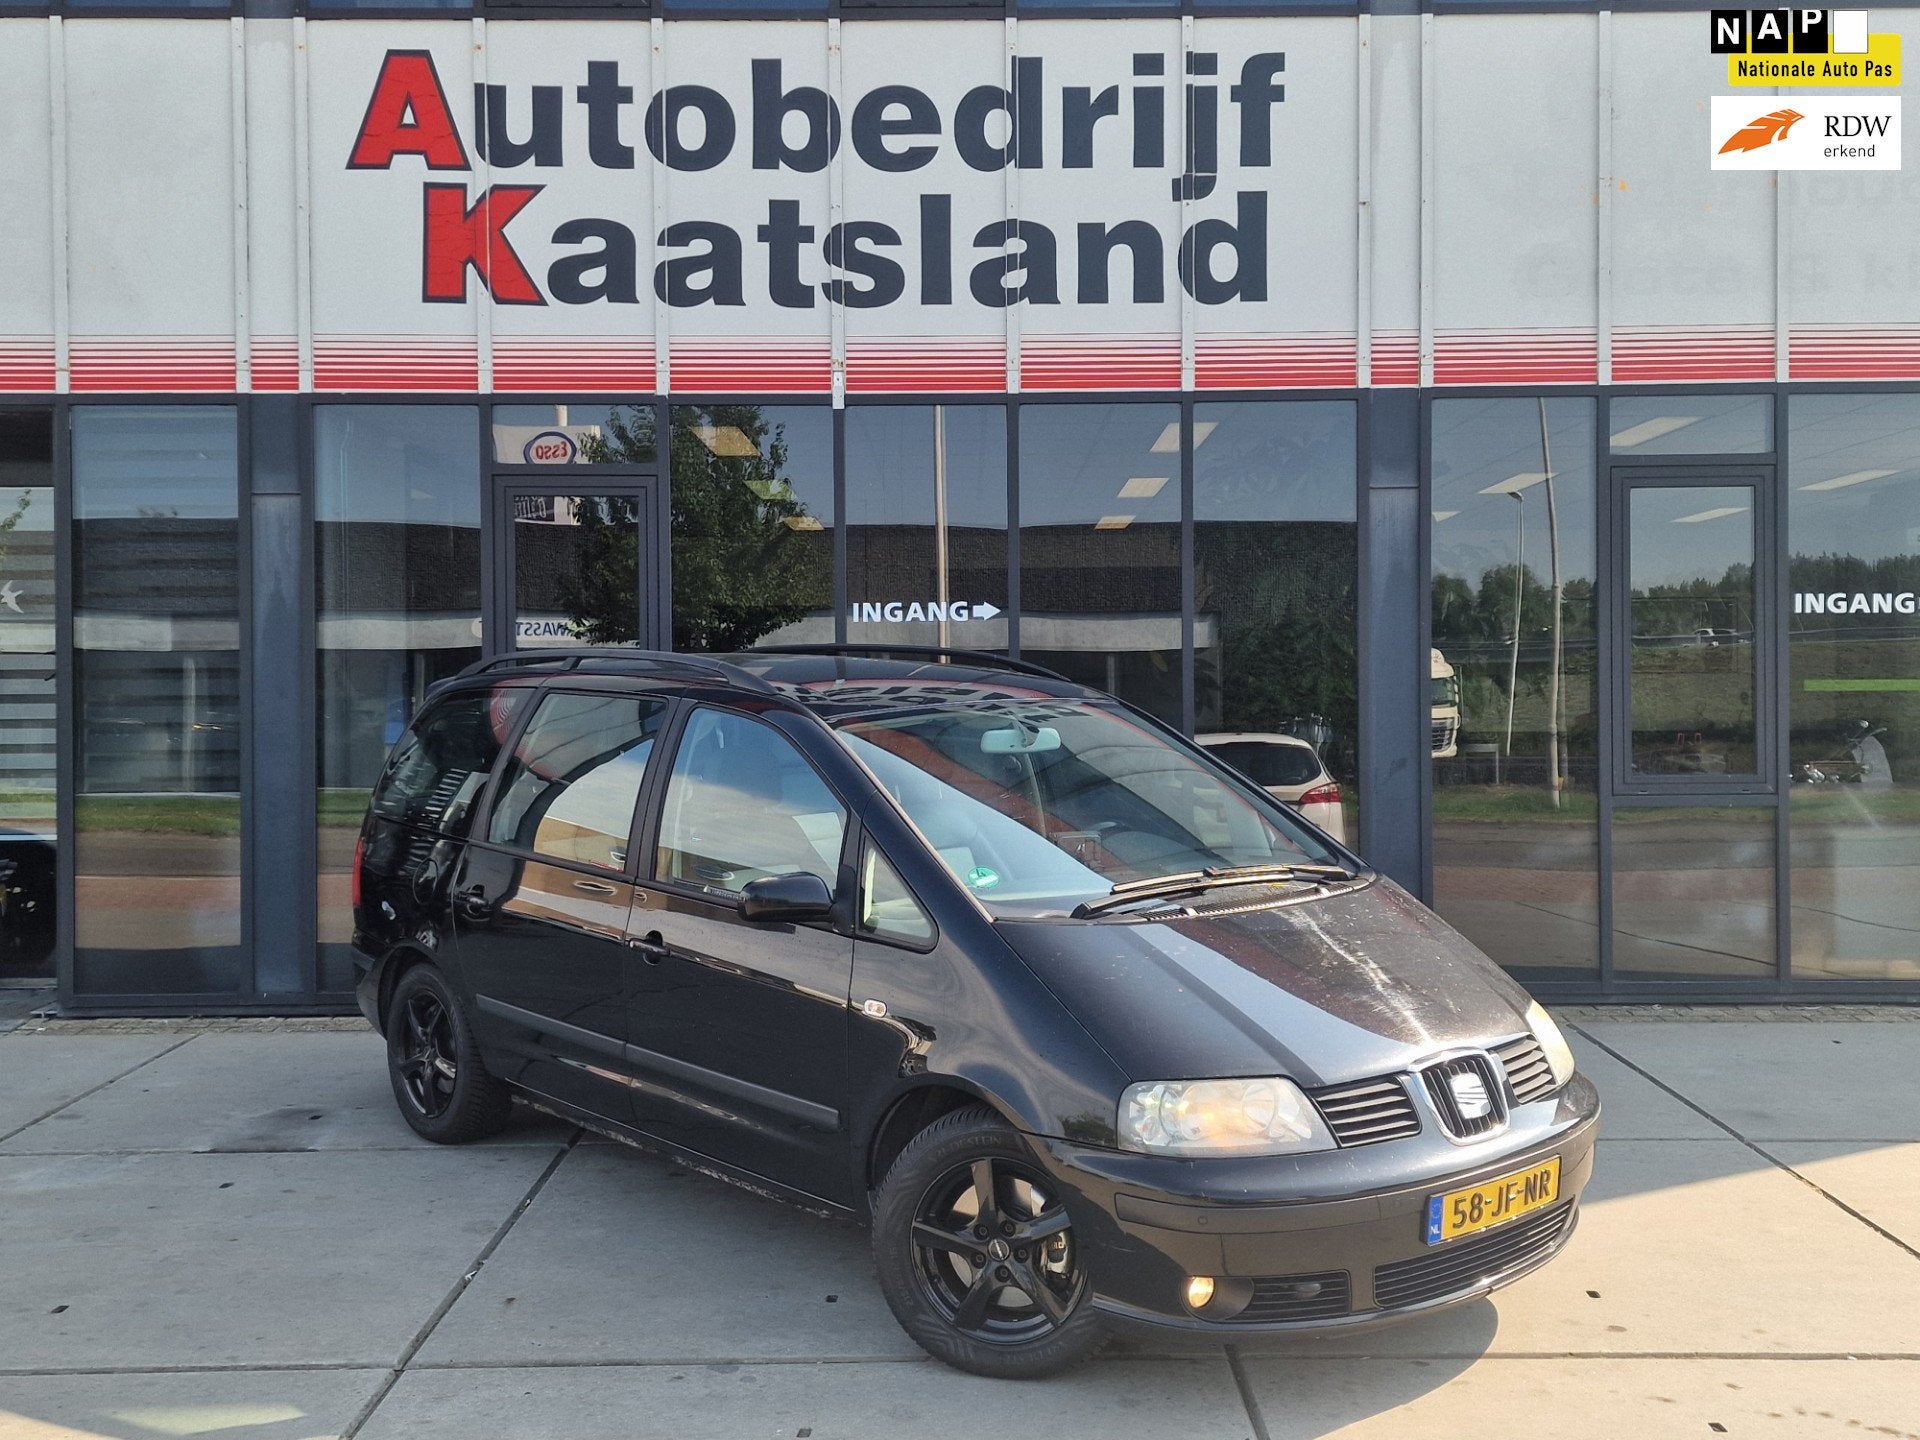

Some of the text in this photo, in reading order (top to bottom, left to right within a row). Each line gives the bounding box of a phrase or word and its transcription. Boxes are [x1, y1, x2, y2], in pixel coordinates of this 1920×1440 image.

[346, 49, 1286, 202] Autobedrijf
[422, 182, 1268, 309] Kaatsland
[852, 601, 969, 623] INGANG
[1794, 592, 1915, 614] INGANG
[1430, 1169, 1552, 1235] NL 58-JF-NR
